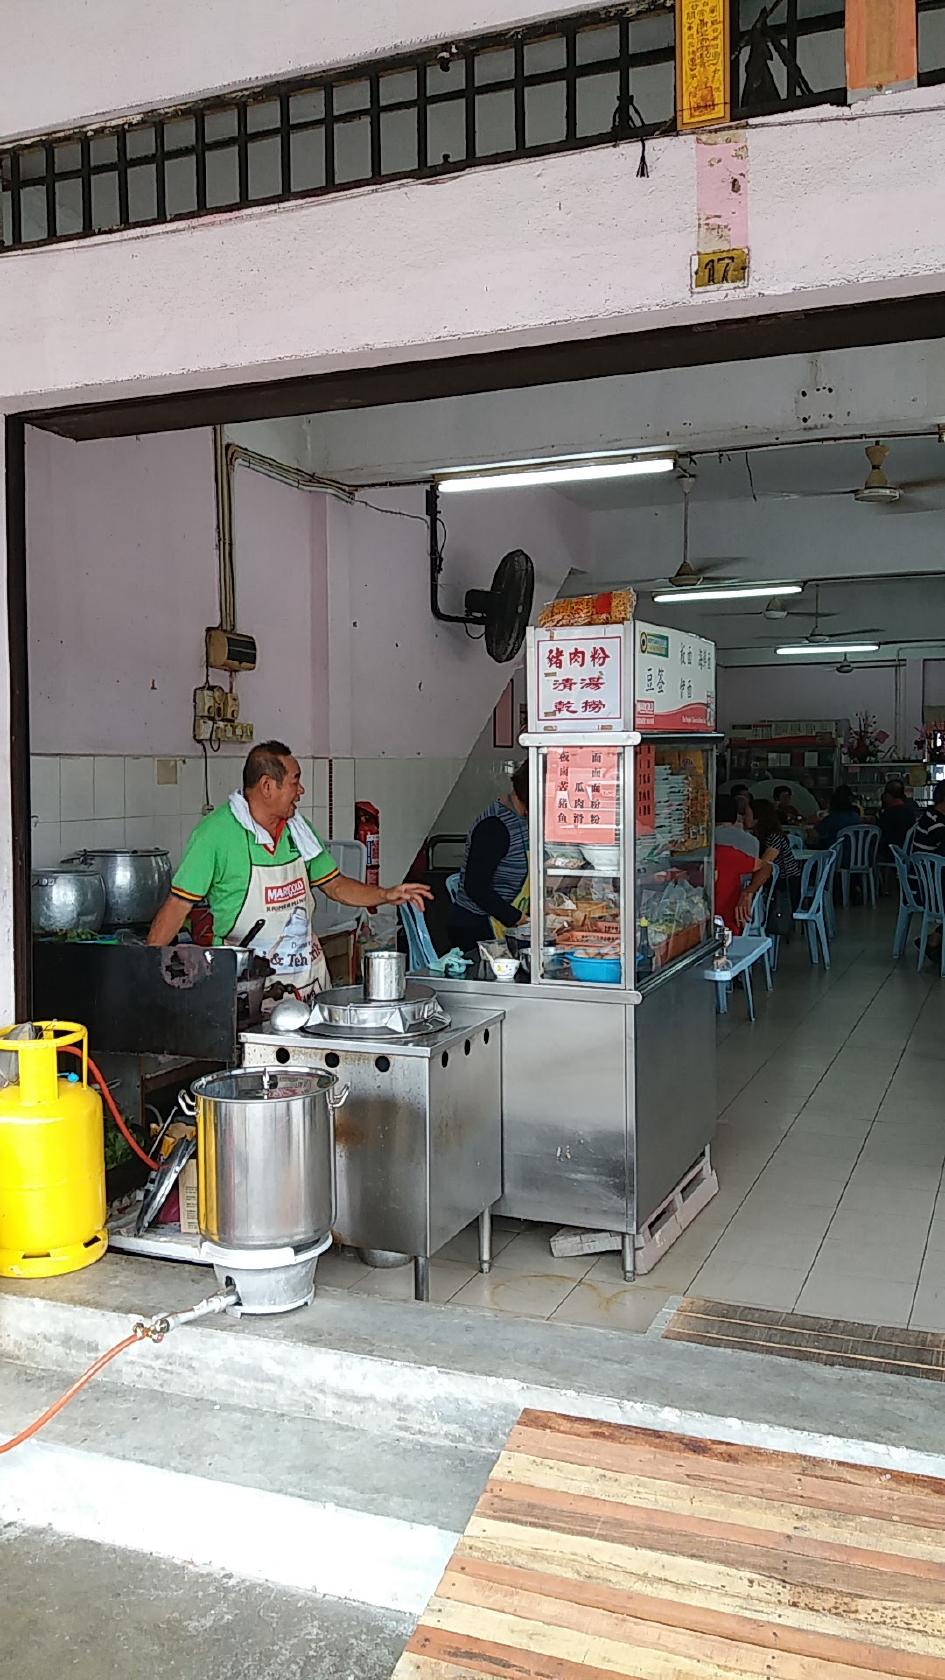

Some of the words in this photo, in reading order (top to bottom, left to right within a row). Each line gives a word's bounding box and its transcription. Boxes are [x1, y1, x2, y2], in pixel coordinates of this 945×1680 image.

[704, 256, 735, 284] 17
[267, 880, 304, 902] MARIGOLD
[287, 952, 308, 967] Teh
